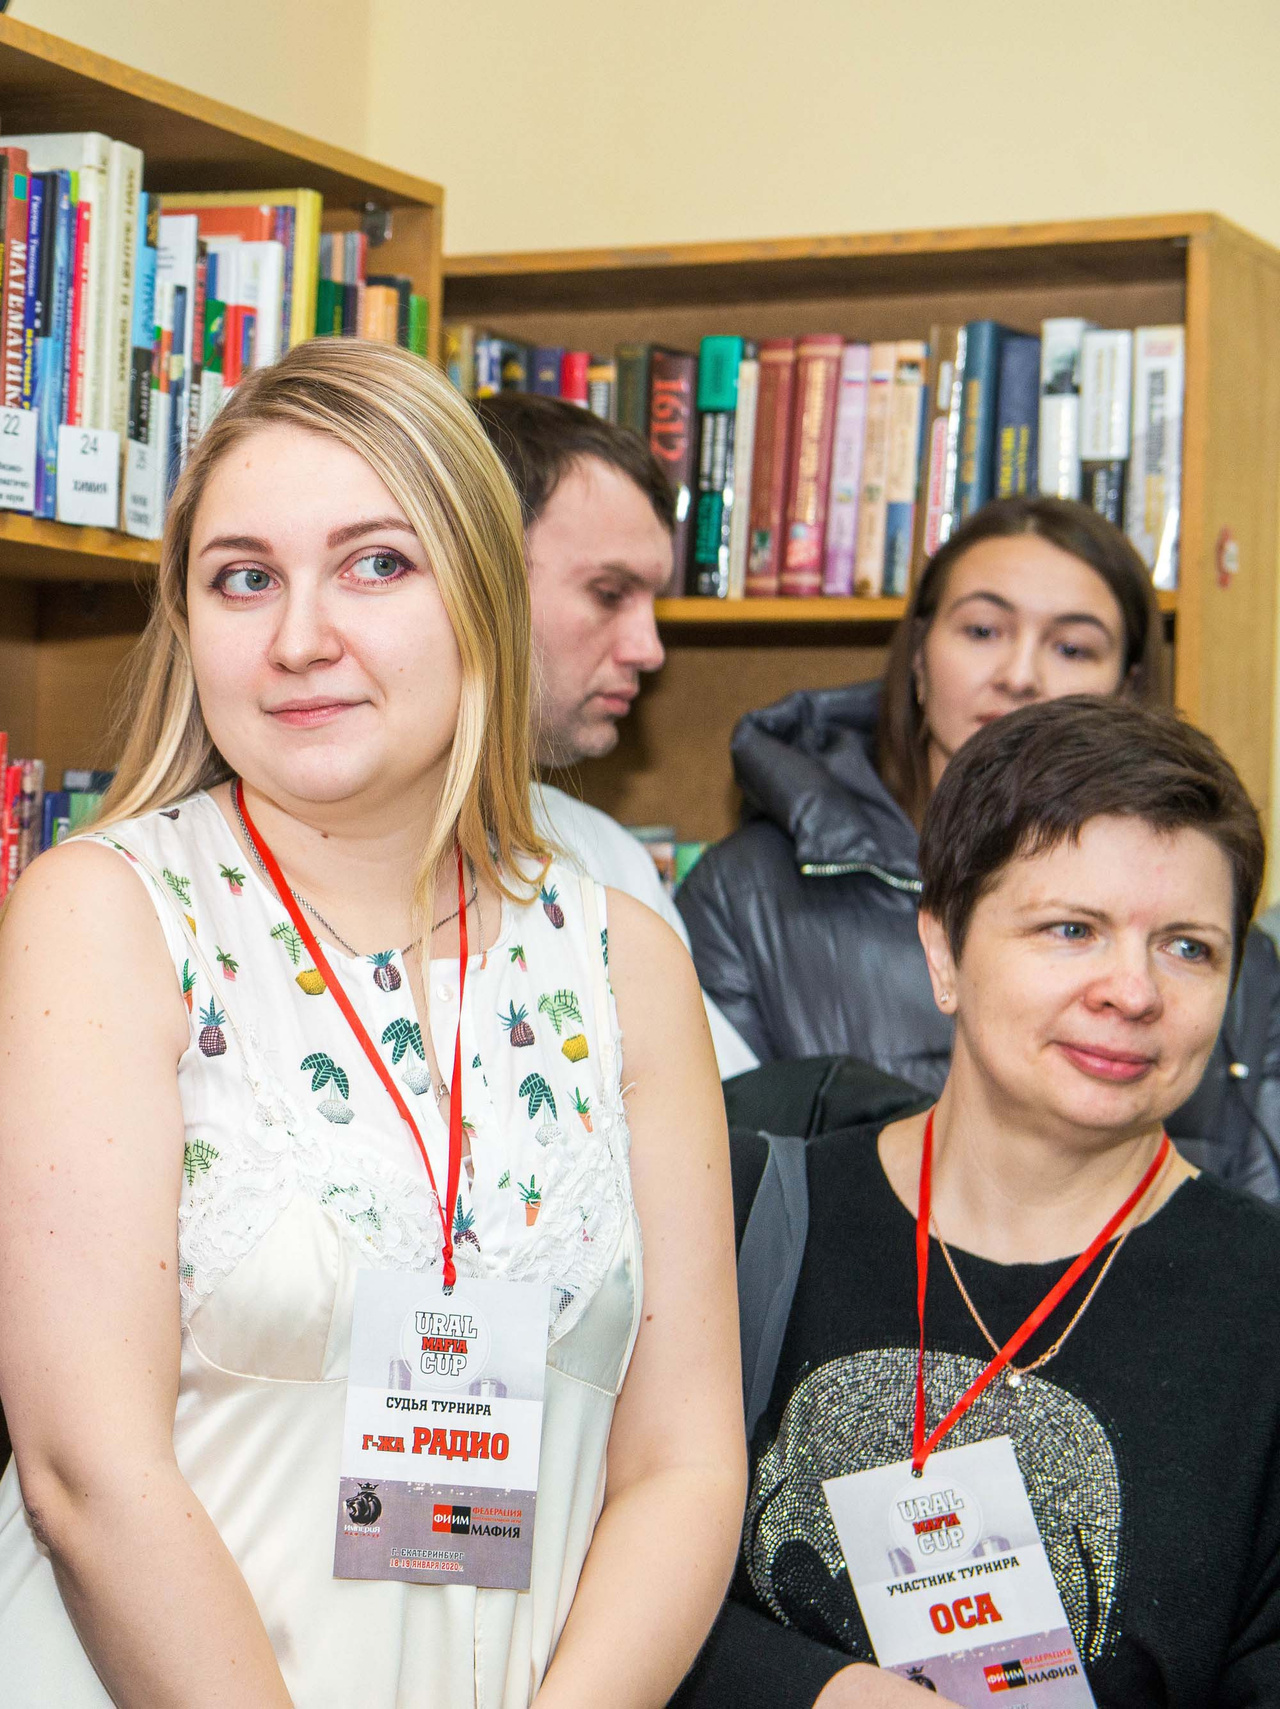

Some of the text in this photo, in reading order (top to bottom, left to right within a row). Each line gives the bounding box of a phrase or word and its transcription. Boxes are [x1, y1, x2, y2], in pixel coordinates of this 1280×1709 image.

[3, 413, 19, 437] 22
[80, 432, 99, 456] 24
[415, 1311, 478, 1339] URAL
[421, 1336, 468, 1354] MAFIA
[420, 1351, 468, 1376] CUP
[385, 1396, 492, 1416] СУДЬЯ ТУРНИРА
[412, 1426, 510, 1462] РАДИО
[472, 1506, 522, 1518] ФЕДЕРАЦИЯ
[896, 1488, 964, 1523] URAL
[470, 1523, 520, 1539] МАФИЯ
[912, 1511, 961, 1535] MAFIA
[916, 1526, 965, 1555] CUP
[400, 1547, 465, 1560] ЕКАТЕРИНБУРГ
[411, 1559, 440, 1570] ЯНВАРЯ
[886, 1555, 1020, 1597] УЧАСТНИК ТУРНИРА
[928, 1591, 1003, 1635] ОСА
[1027, 1663, 1080, 1685] МАФИЯ
